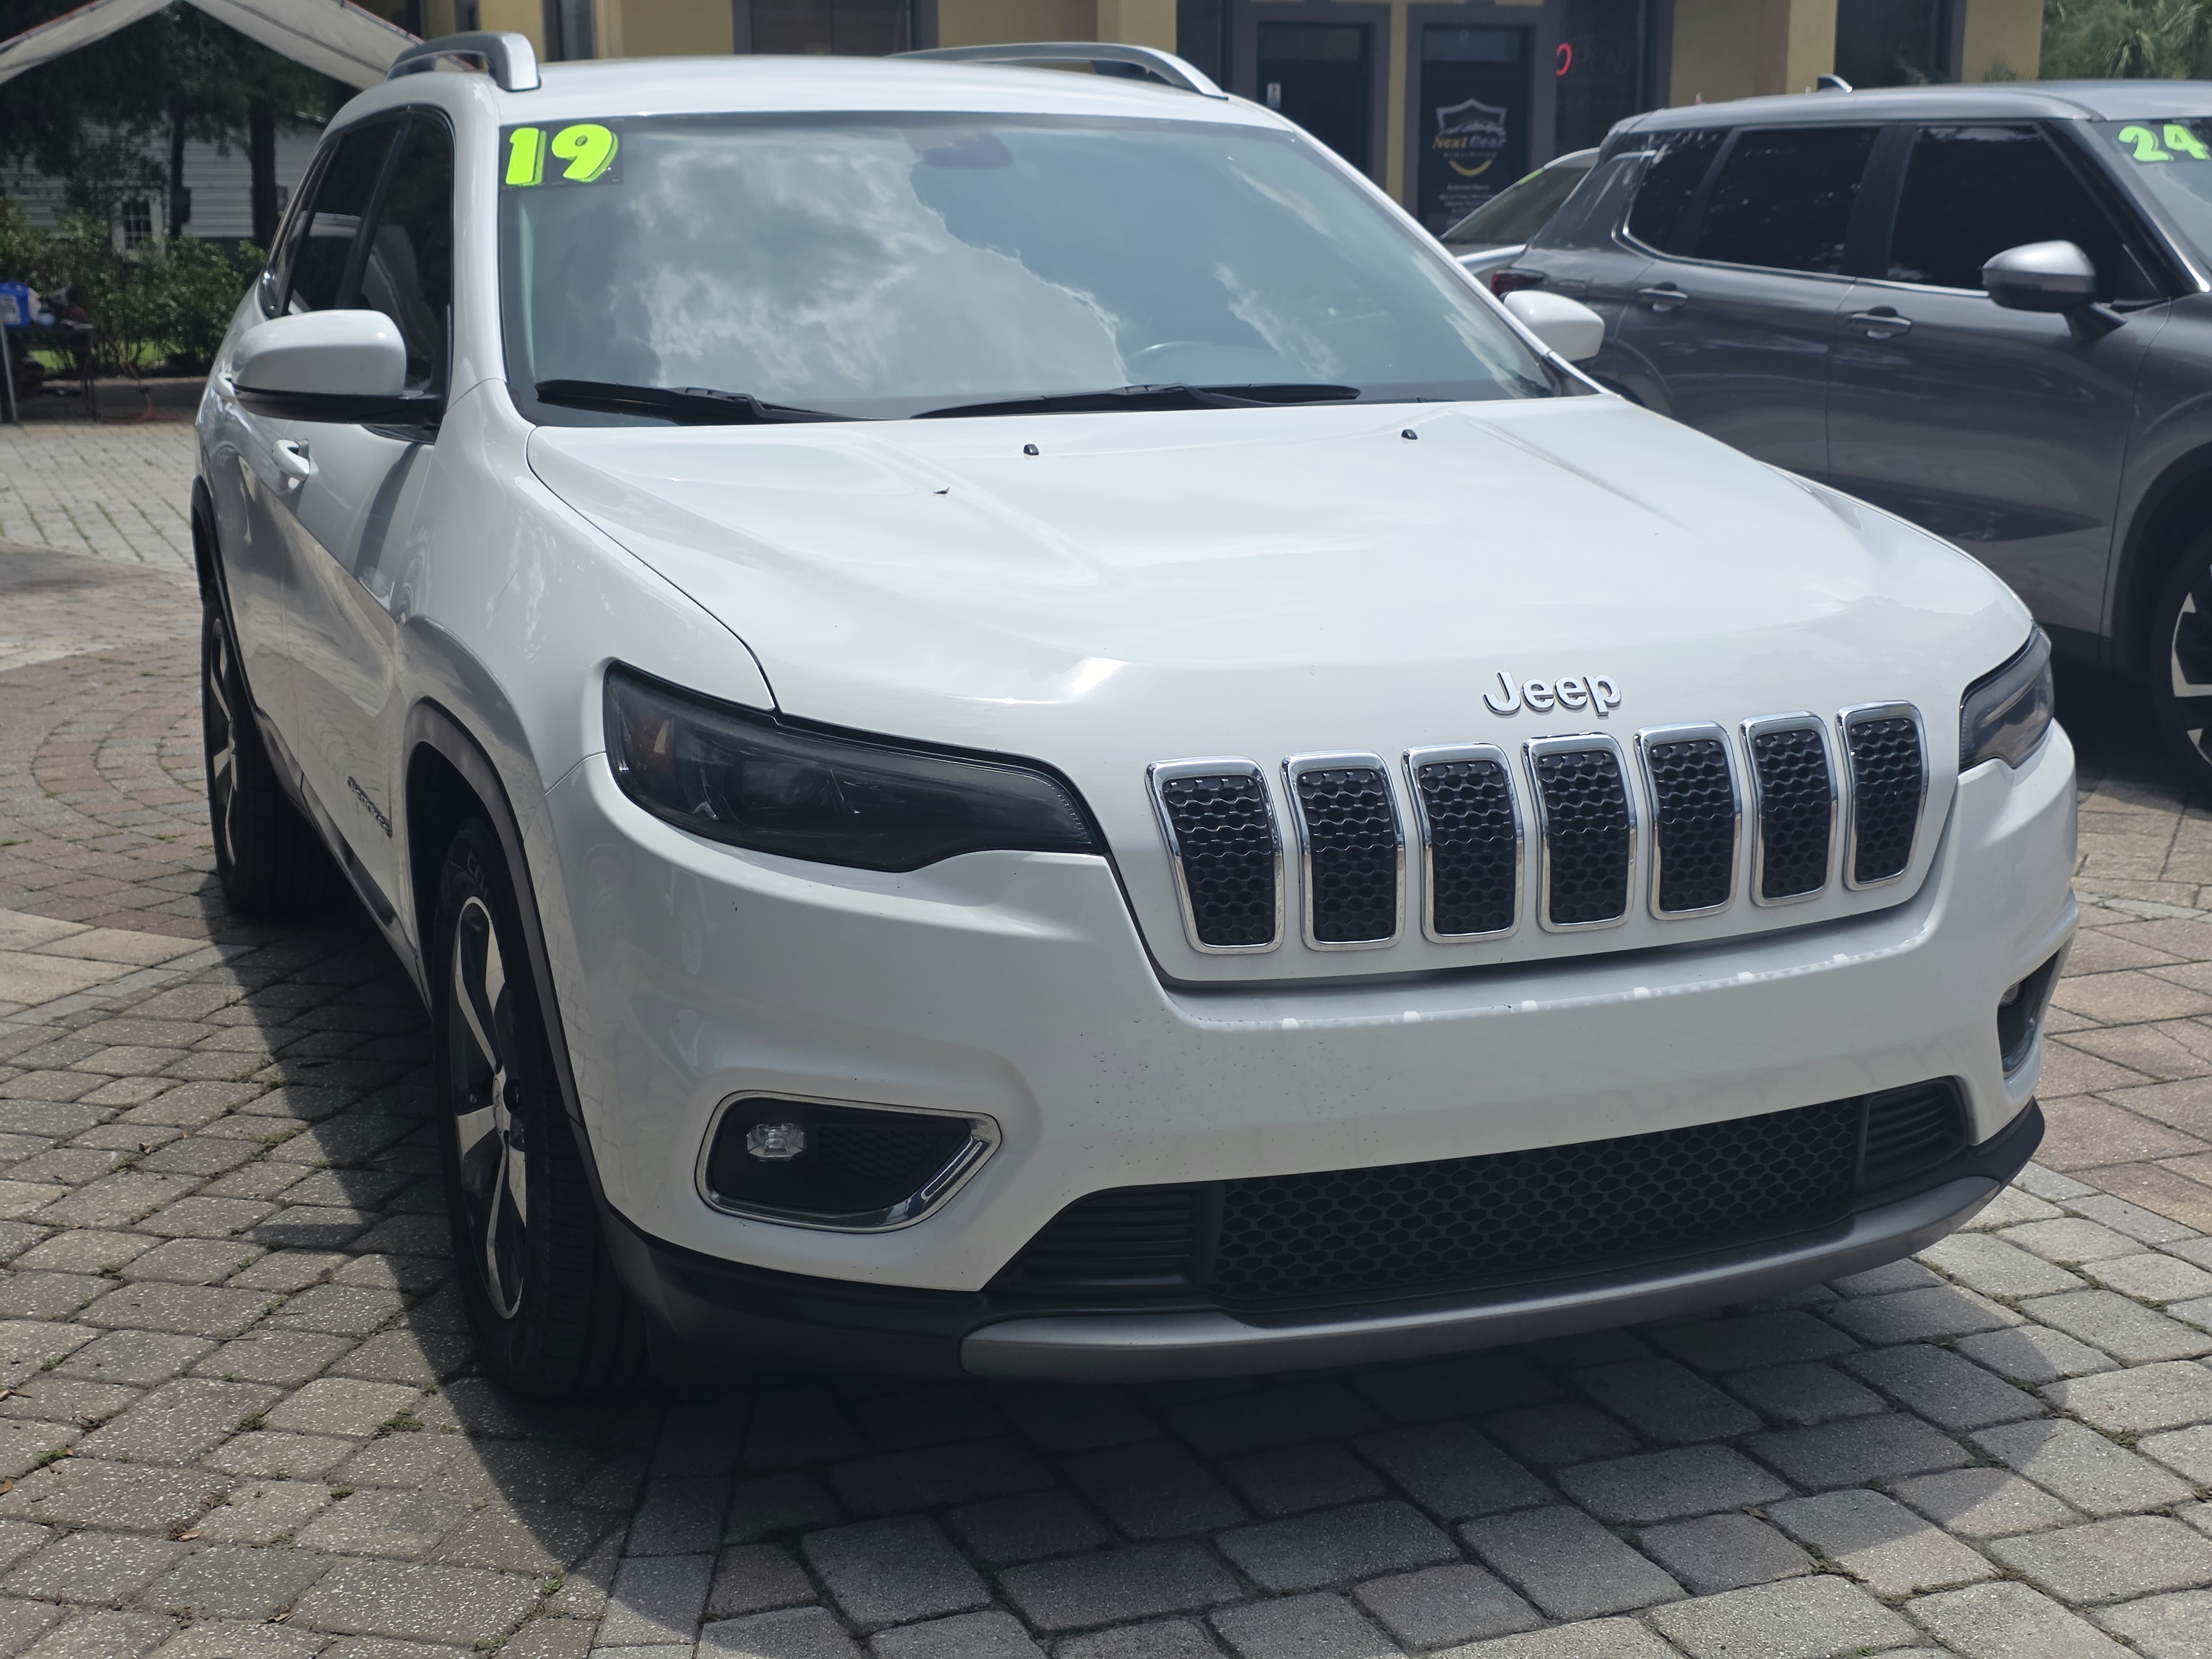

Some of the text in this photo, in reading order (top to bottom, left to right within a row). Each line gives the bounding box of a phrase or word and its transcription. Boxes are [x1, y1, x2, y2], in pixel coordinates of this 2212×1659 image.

[505, 124, 618, 186] 19
[1432, 135, 1506, 149] Next Gear
[2119, 124, 2210, 162] 24
[1483, 671, 1622, 717] Jeep
